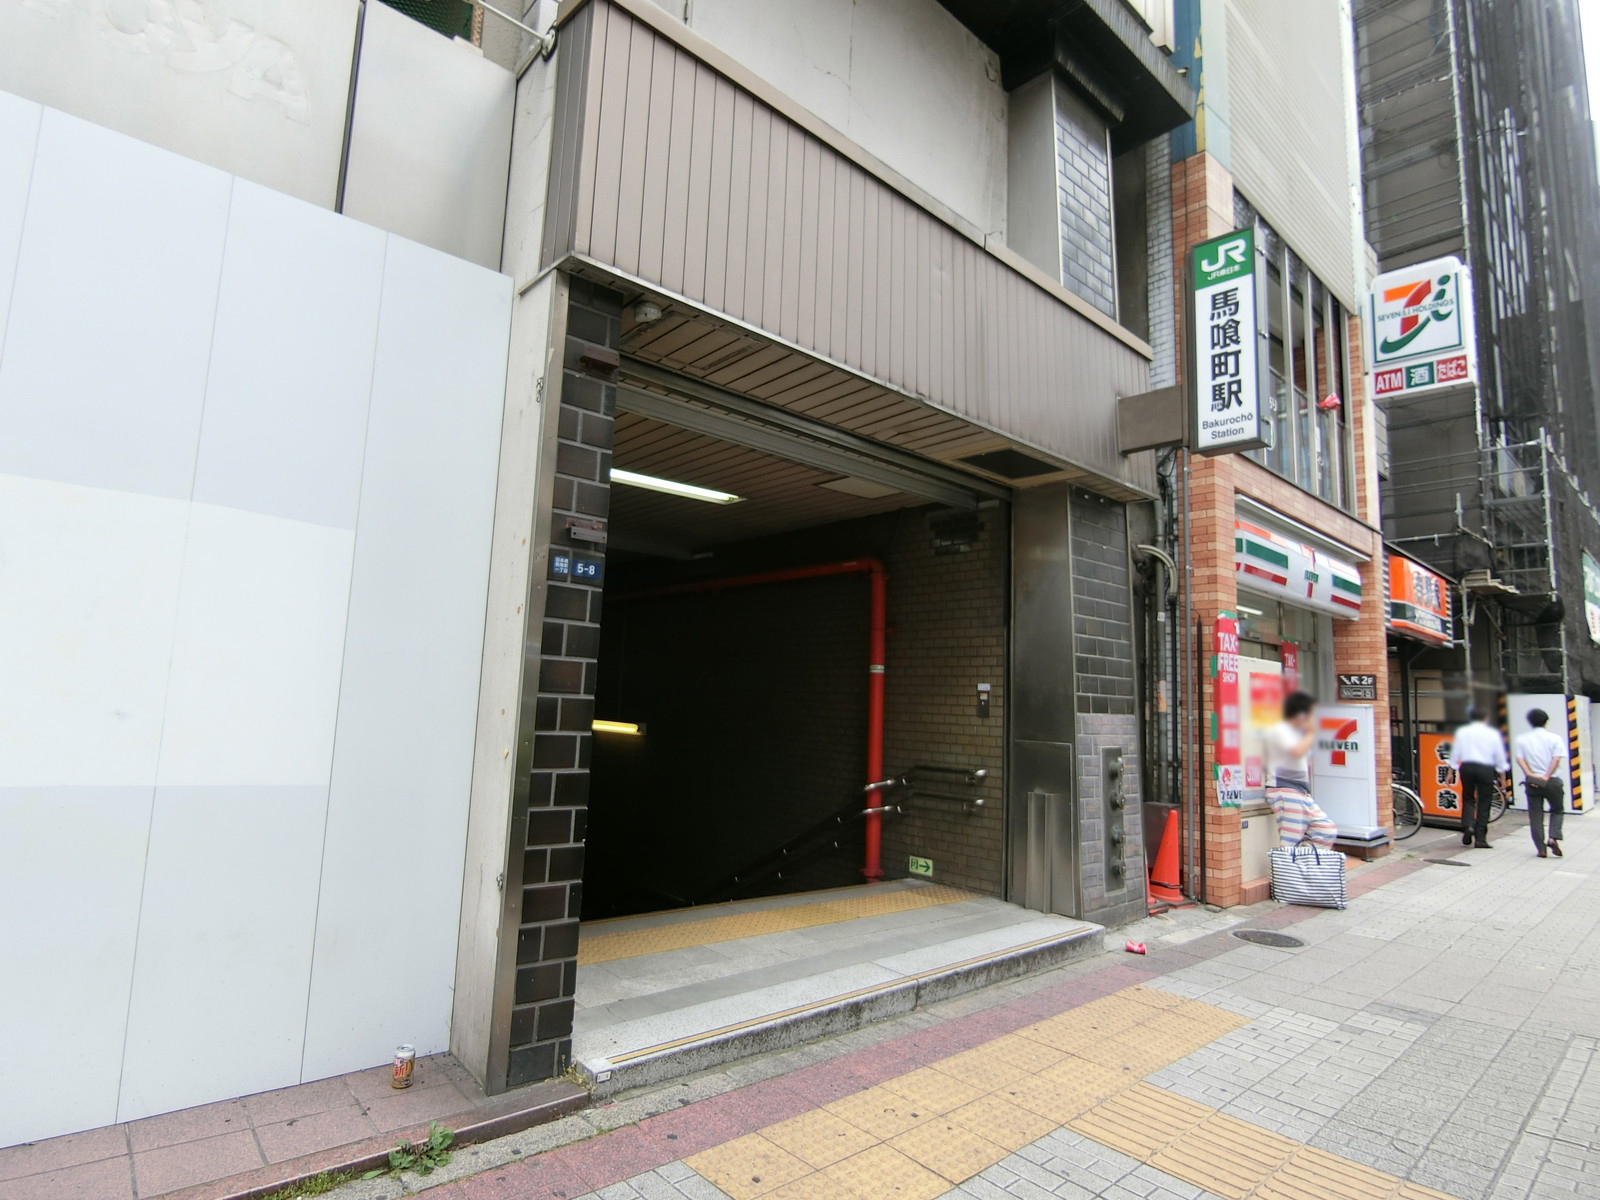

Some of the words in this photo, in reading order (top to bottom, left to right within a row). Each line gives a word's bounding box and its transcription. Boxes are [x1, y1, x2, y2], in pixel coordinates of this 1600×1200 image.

[1201, 238, 1247, 273] JR
[1412, 298, 1455, 315] HOLDINGS
[1210, 287, 1243, 412] 馬喰町駅
[1410, 366, 1430, 386] 酒
[1437, 358, 1466, 379] たばこ
[1375, 372, 1402, 392] ATM
[1211, 427, 1244, 440] Station
[577, 563, 595, 575] 5-8
[1217, 652, 1238, 671] FREE
[1222, 672, 1236, 683] SHOP
[1361, 675, 1374, 685] 2F
